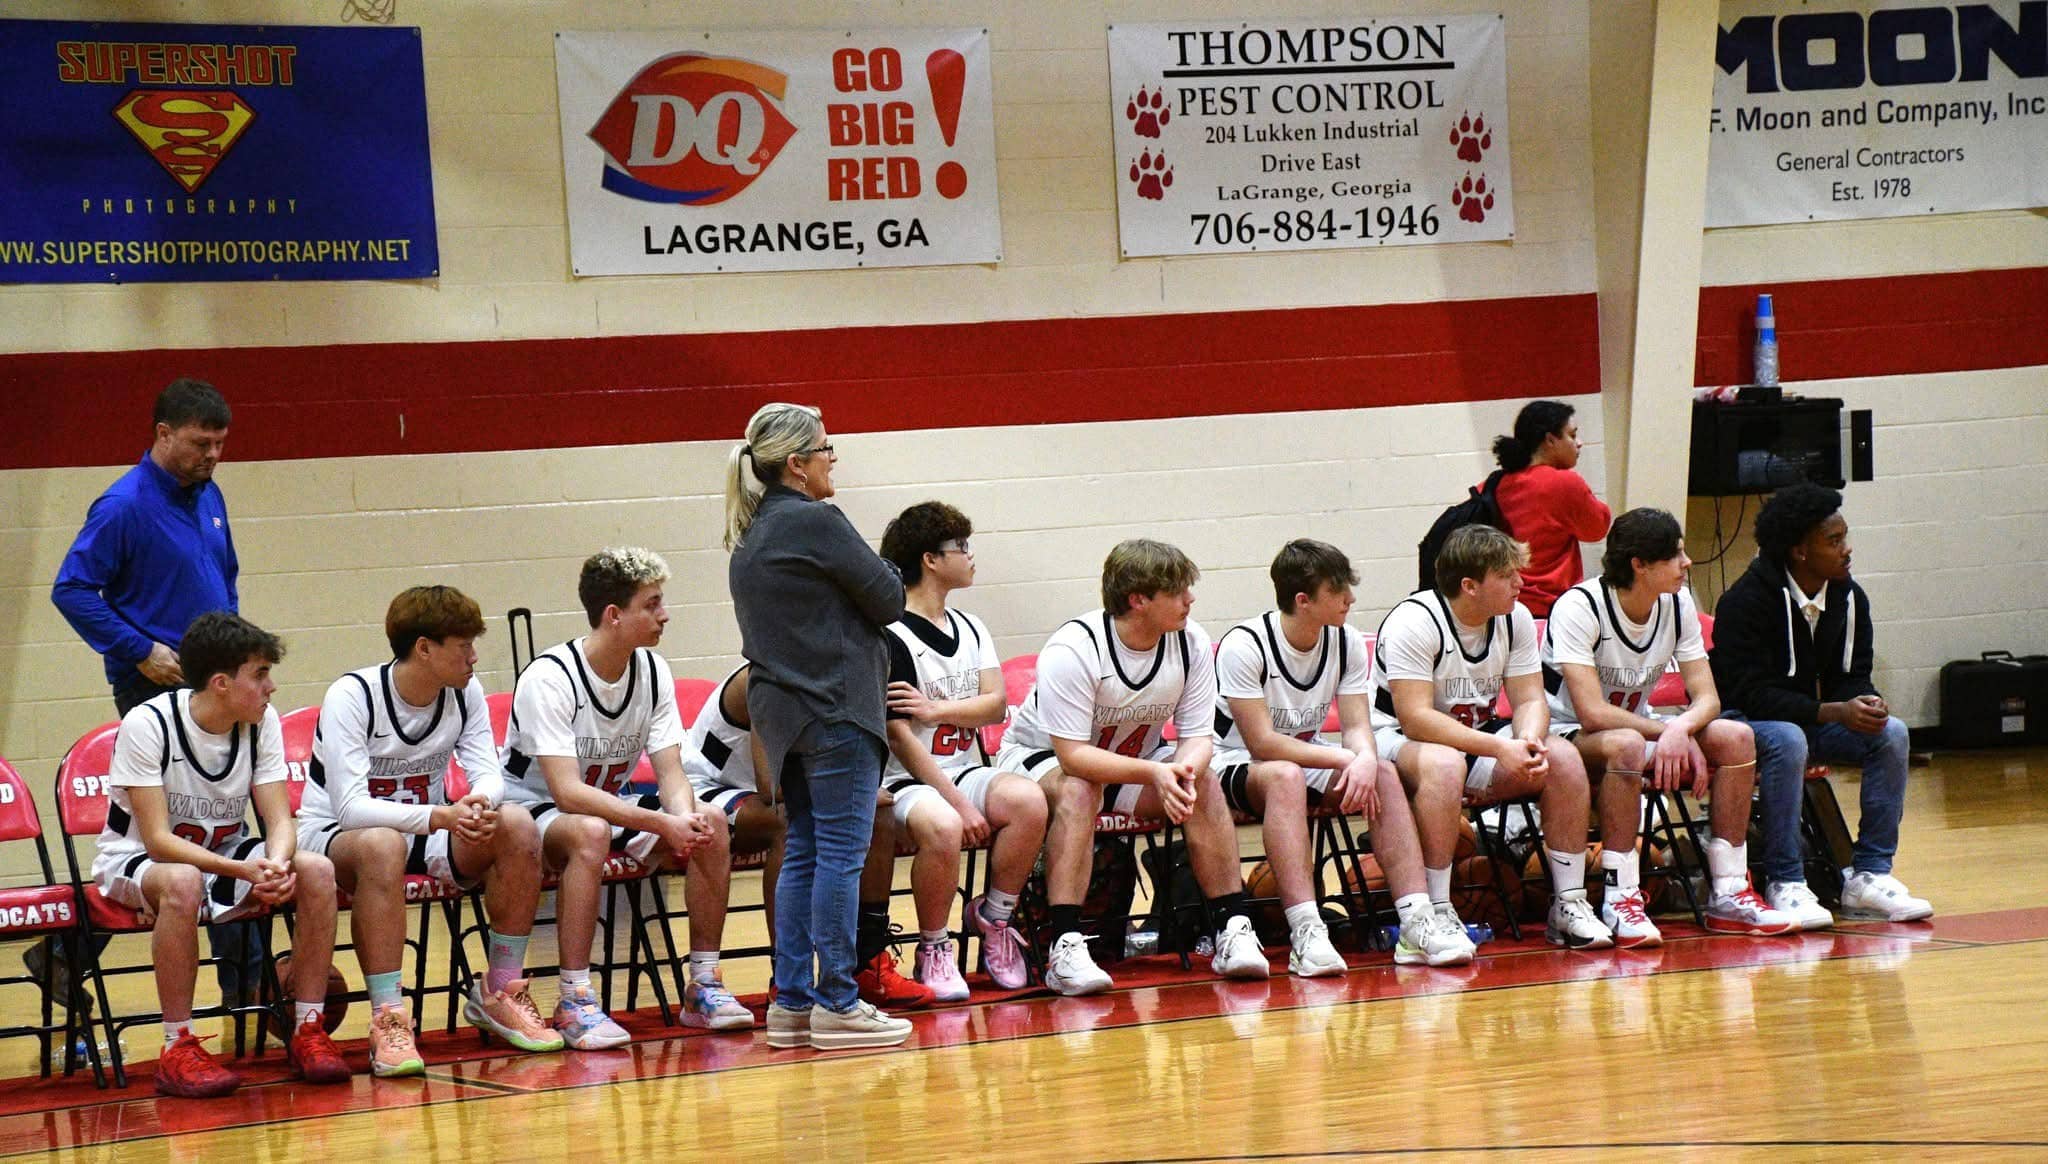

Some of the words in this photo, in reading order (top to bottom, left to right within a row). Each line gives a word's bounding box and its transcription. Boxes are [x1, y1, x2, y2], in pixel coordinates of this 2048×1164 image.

[57, 40, 297, 86] SUPERSHOT
[1167, 24, 1446, 67] THOMPSON
[1715, 0, 2048, 93] MOON
[832, 47, 904, 93] GO
[1177, 86, 1261, 117] PEST
[1271, 79, 1444, 113] CONTROL
[1736, 106, 1811, 132] Moon
[1821, 102, 1867, 127] and
[1876, 96, 1999, 126] Company,
[626, 90, 766, 176] DQ
[827, 101, 914, 147] BIG
[1205, 125, 1236, 144] 204
[1243, 122, 1317, 143] Lukken
[1323, 118, 1420, 140] Industrial
[1261, 153, 1315, 173] Drive
[1322, 151, 1361, 171] East
[1776, 149, 1850, 172] General
[1856, 145, 1965, 168] Contractors
[827, 156, 921, 202] RED
[1217, 184, 1325, 203] LaGrange,
[1331, 180, 1412, 201] Georgia
[1832, 181, 1865, 202] Est.
[1873, 177, 1912, 199] 1978
[82, 198, 298, 215] PHOTOGRAPHY
[1191, 204, 1440, 246] 706-884-1946
[643, 220, 865, 257] LAGRANGE,
[877, 218, 930, 249] GA
[1094, 703, 1175, 726] WILDCATS
[1096, 724, 1151, 758] 14
